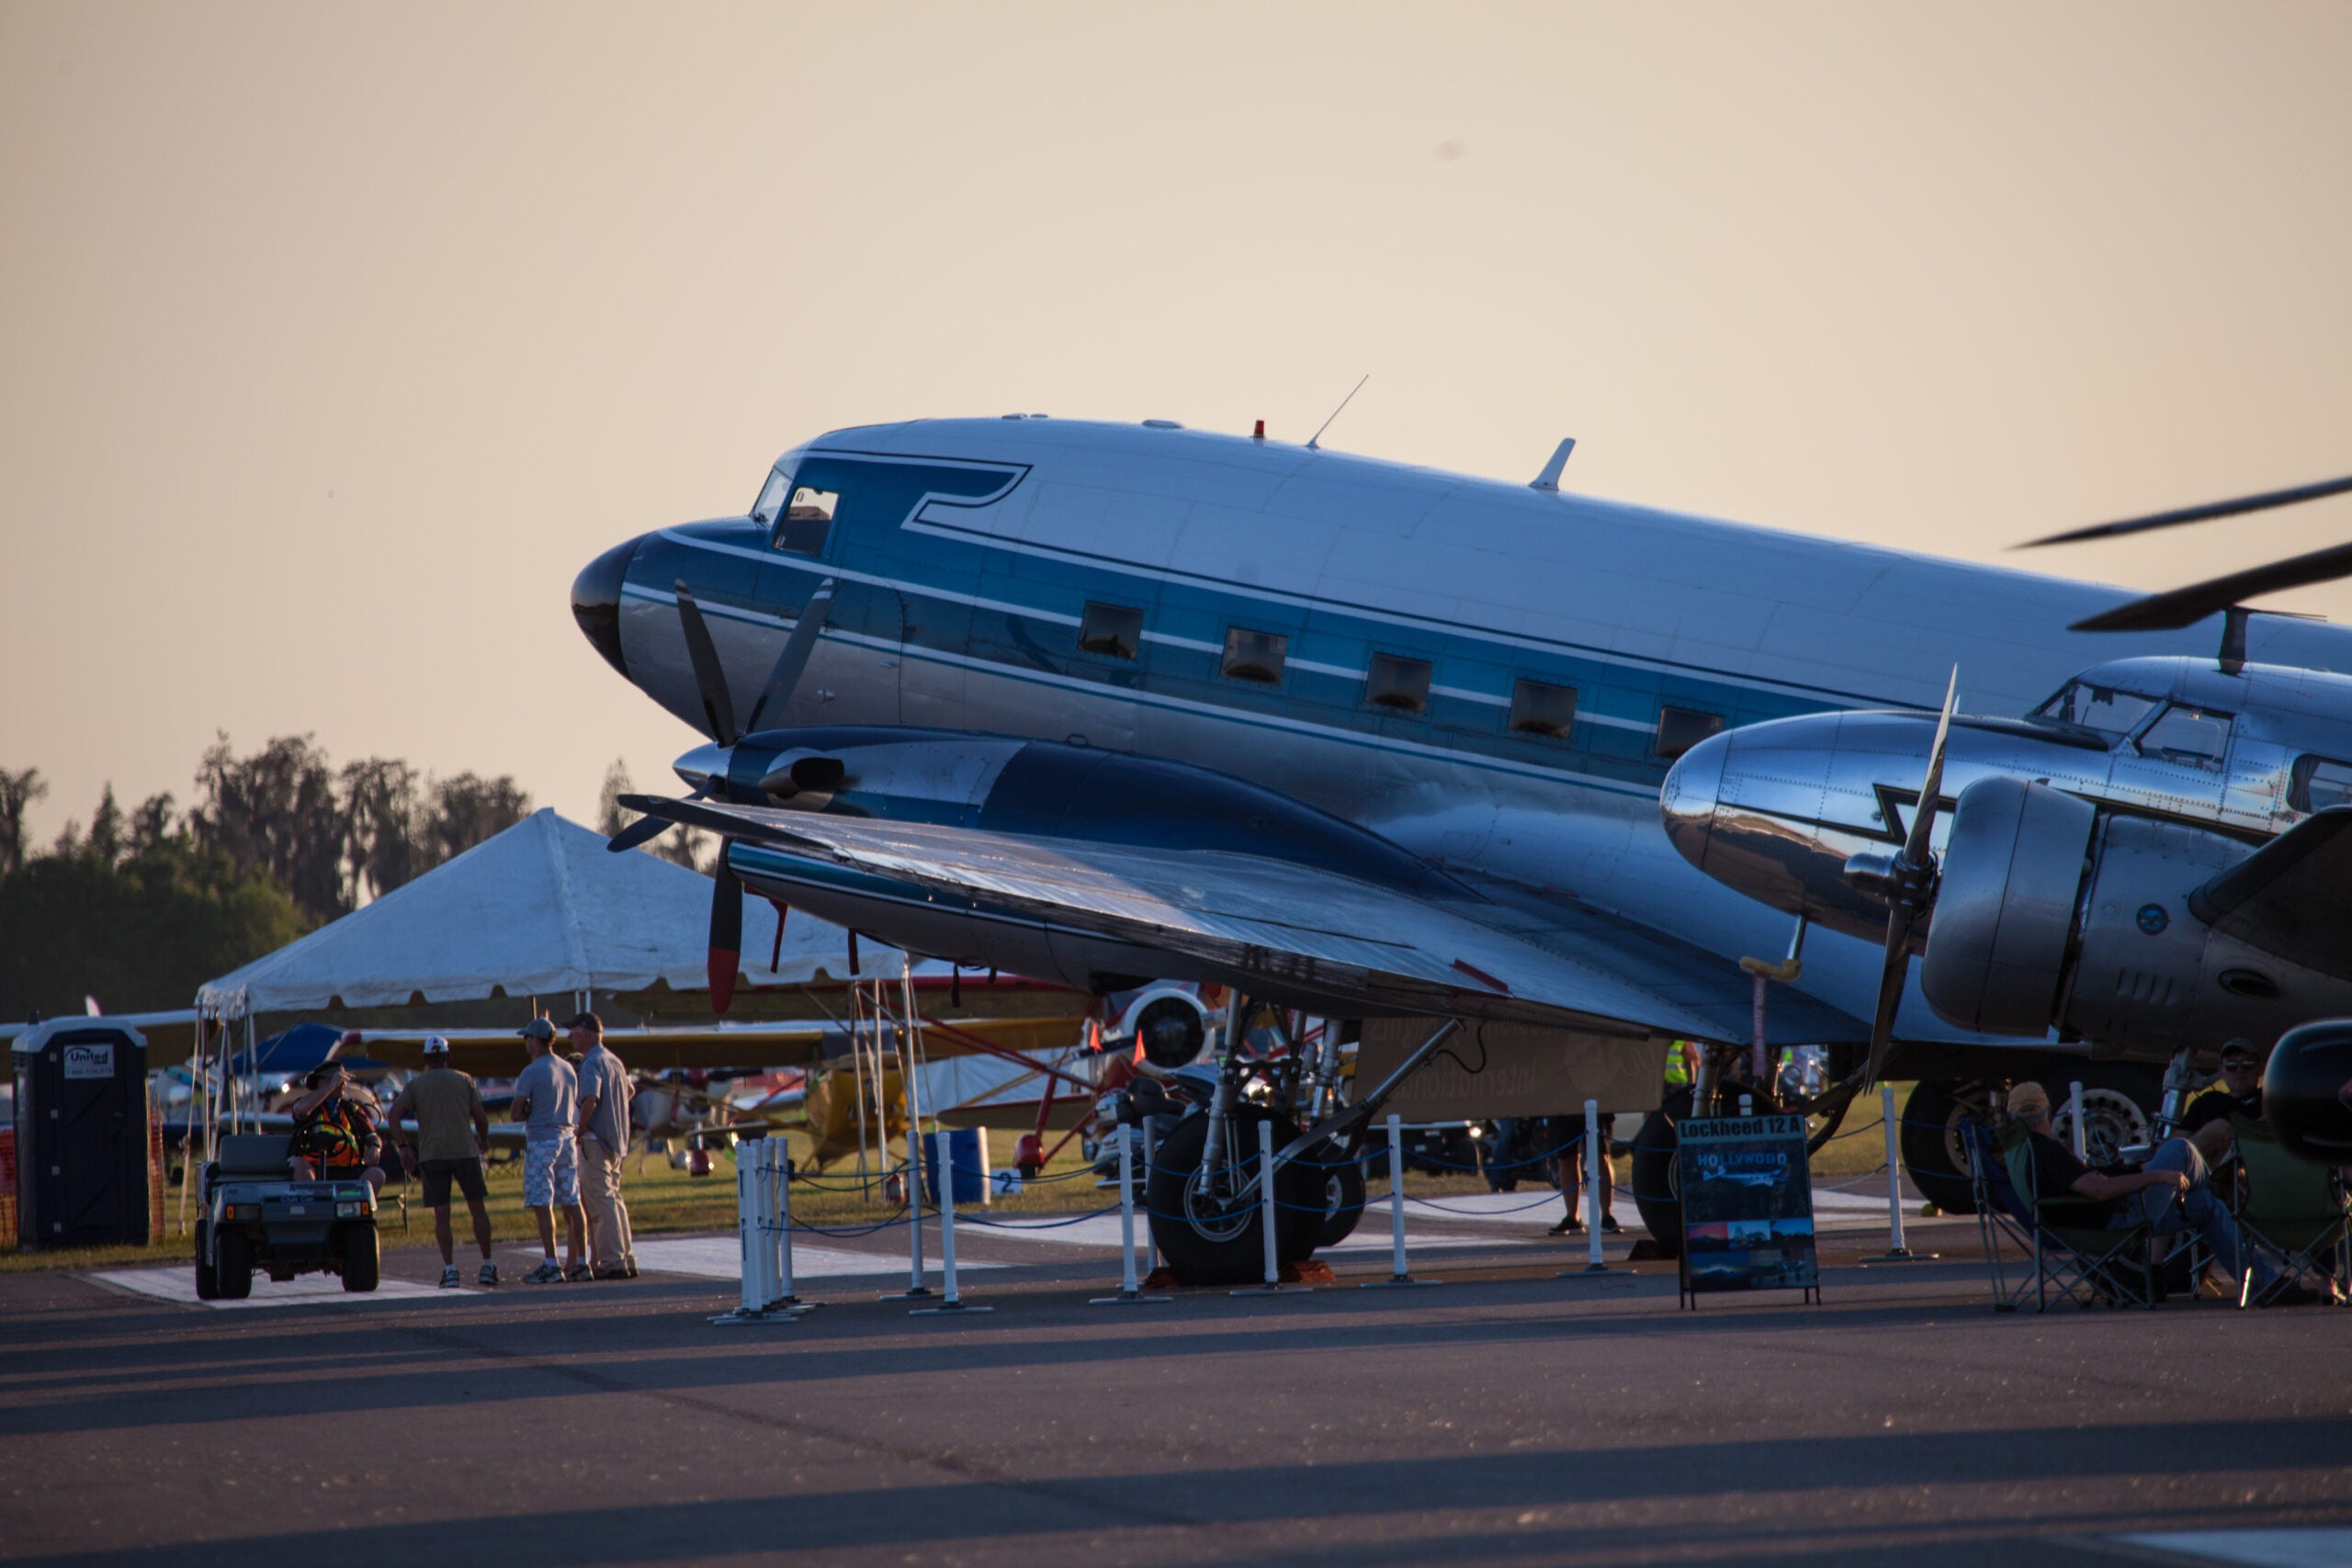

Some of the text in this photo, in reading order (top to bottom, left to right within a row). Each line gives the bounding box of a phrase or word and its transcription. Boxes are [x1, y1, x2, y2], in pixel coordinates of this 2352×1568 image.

[71, 1051, 108, 1064] United
[1680, 1117, 1801, 1139] Lockheed 12 A
[1697, 1152, 1787, 1168] HOLLYWOOD
[1000, 1172, 1014, 1193] 2
